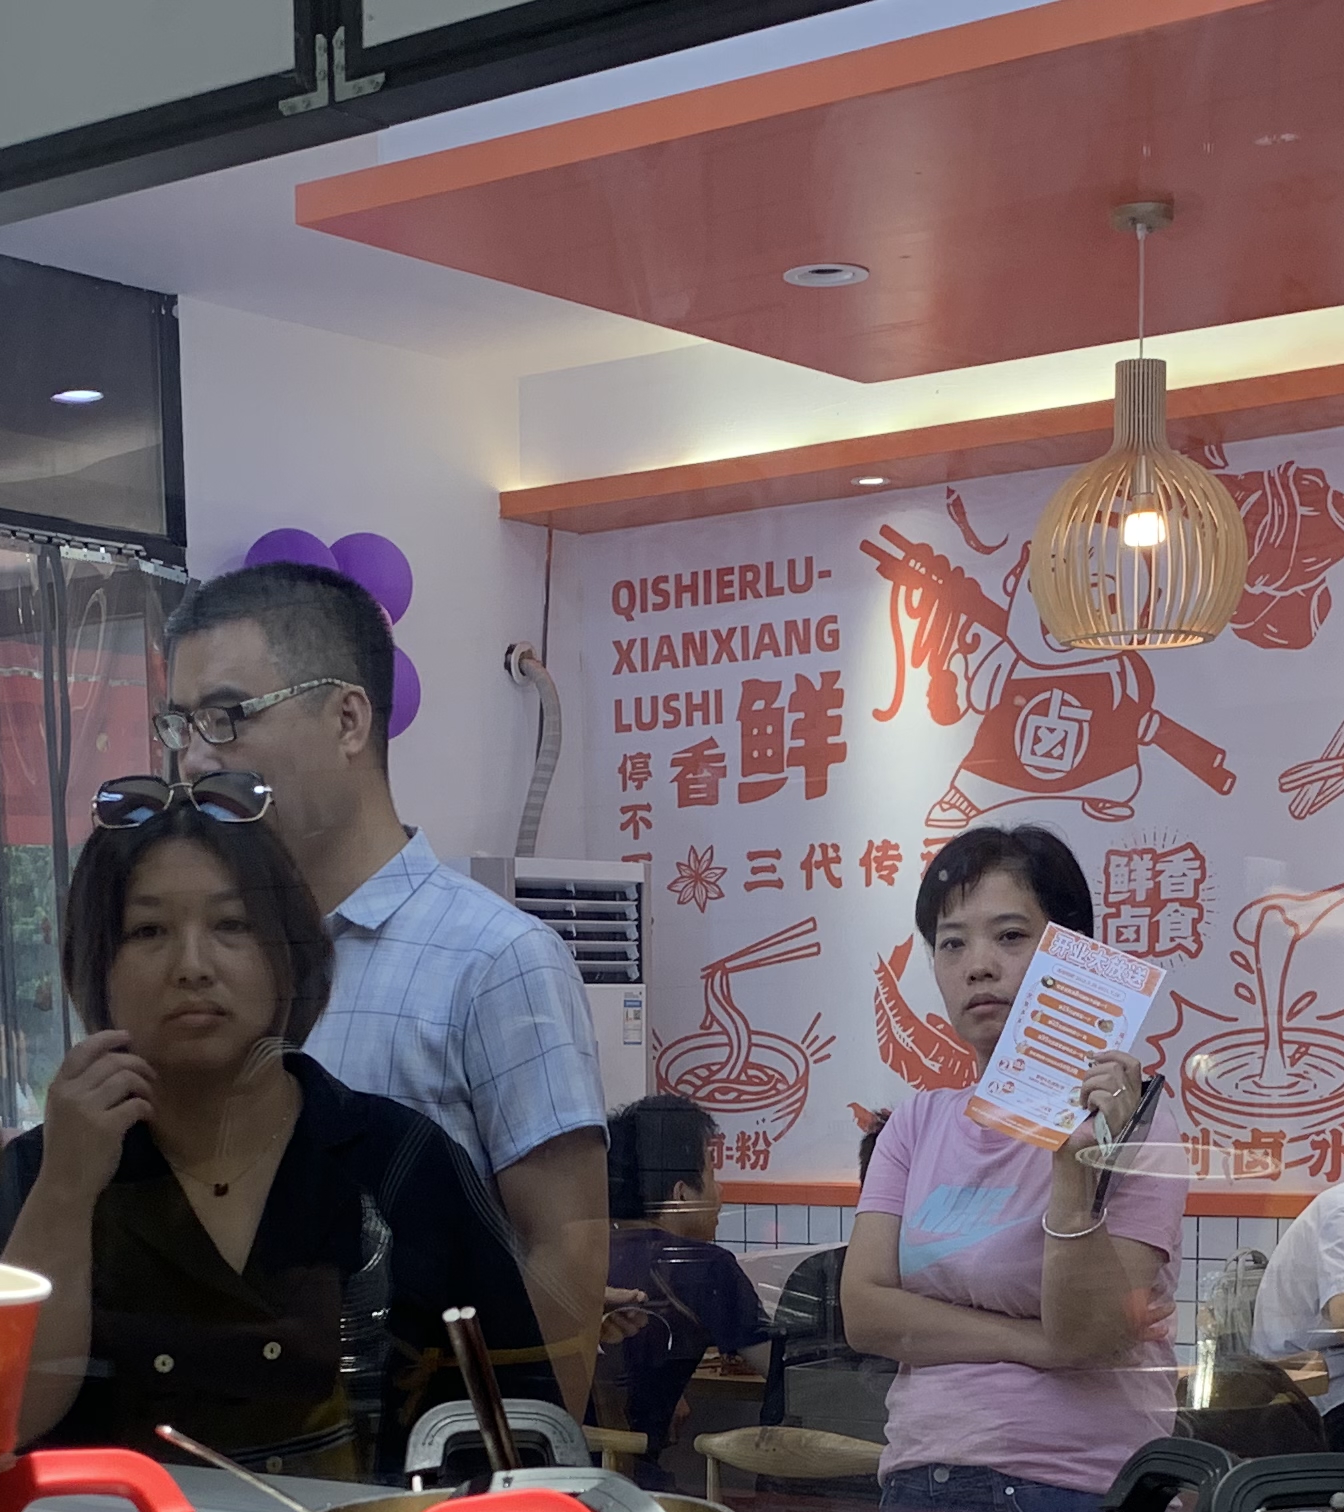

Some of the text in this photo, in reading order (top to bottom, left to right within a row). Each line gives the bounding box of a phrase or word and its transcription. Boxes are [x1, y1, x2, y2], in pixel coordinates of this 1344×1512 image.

[611, 556, 833, 622] QISHIERLU-
[611, 615, 841, 676] XIANXIANG
[614, 688, 724, 734] LUSHI
[736, 670, 847, 805] 鲜
[669, 736, 728, 808] 香
[1106, 846, 1204, 902] 鲜香
[1106, 901, 1201, 955] 卤食
[1048, 930, 1149, 991] 开业大放送
